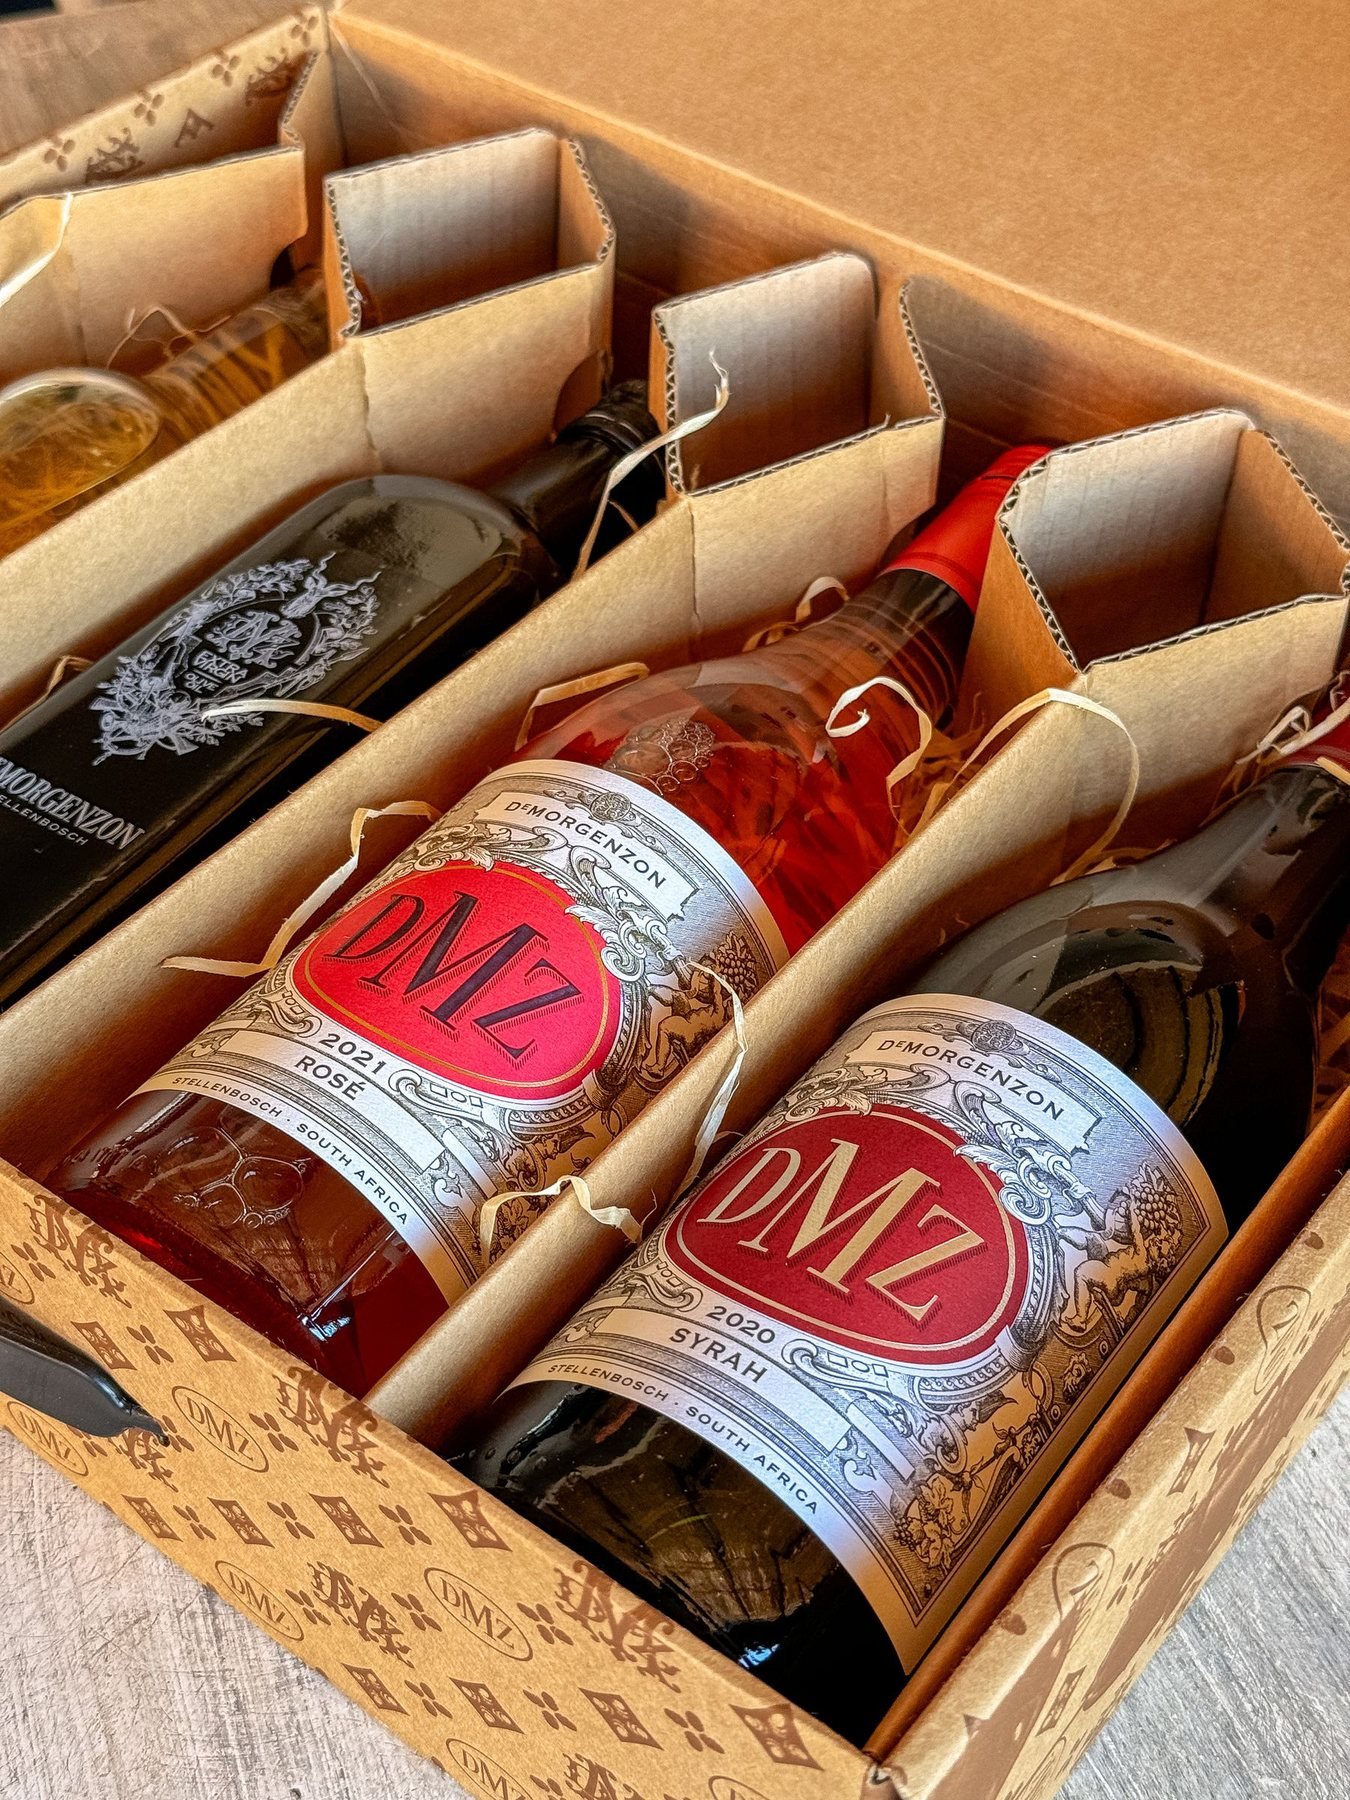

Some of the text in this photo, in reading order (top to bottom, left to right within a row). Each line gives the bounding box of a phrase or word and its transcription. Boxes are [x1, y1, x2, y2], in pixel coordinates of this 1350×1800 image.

[185, 673, 220, 691] OLIVE
[185, 681, 203, 694] OIL
[321, 890, 584, 1069] DMZ
[294, 1054, 366, 1101] ROSÉ
[319, 1032, 387, 1075] 2021
[172, 1076, 408, 1225] STELLENBOSCH SOUTH AFRICA
[696, 1138, 988, 1331] DMZ
[706, 1305, 776, 1345] 2020
[669, 1327, 769, 1384] SYRAH
[18, 1410, 77, 1467] DMZ
[183, 1393, 254, 1462] DMZ
[547, 1364, 818, 1515] STELLENBOSCH SOUTH AFRICA
[226, 1568, 291, 1632] DMZ
[439, 1576, 515, 1650] DMZ
